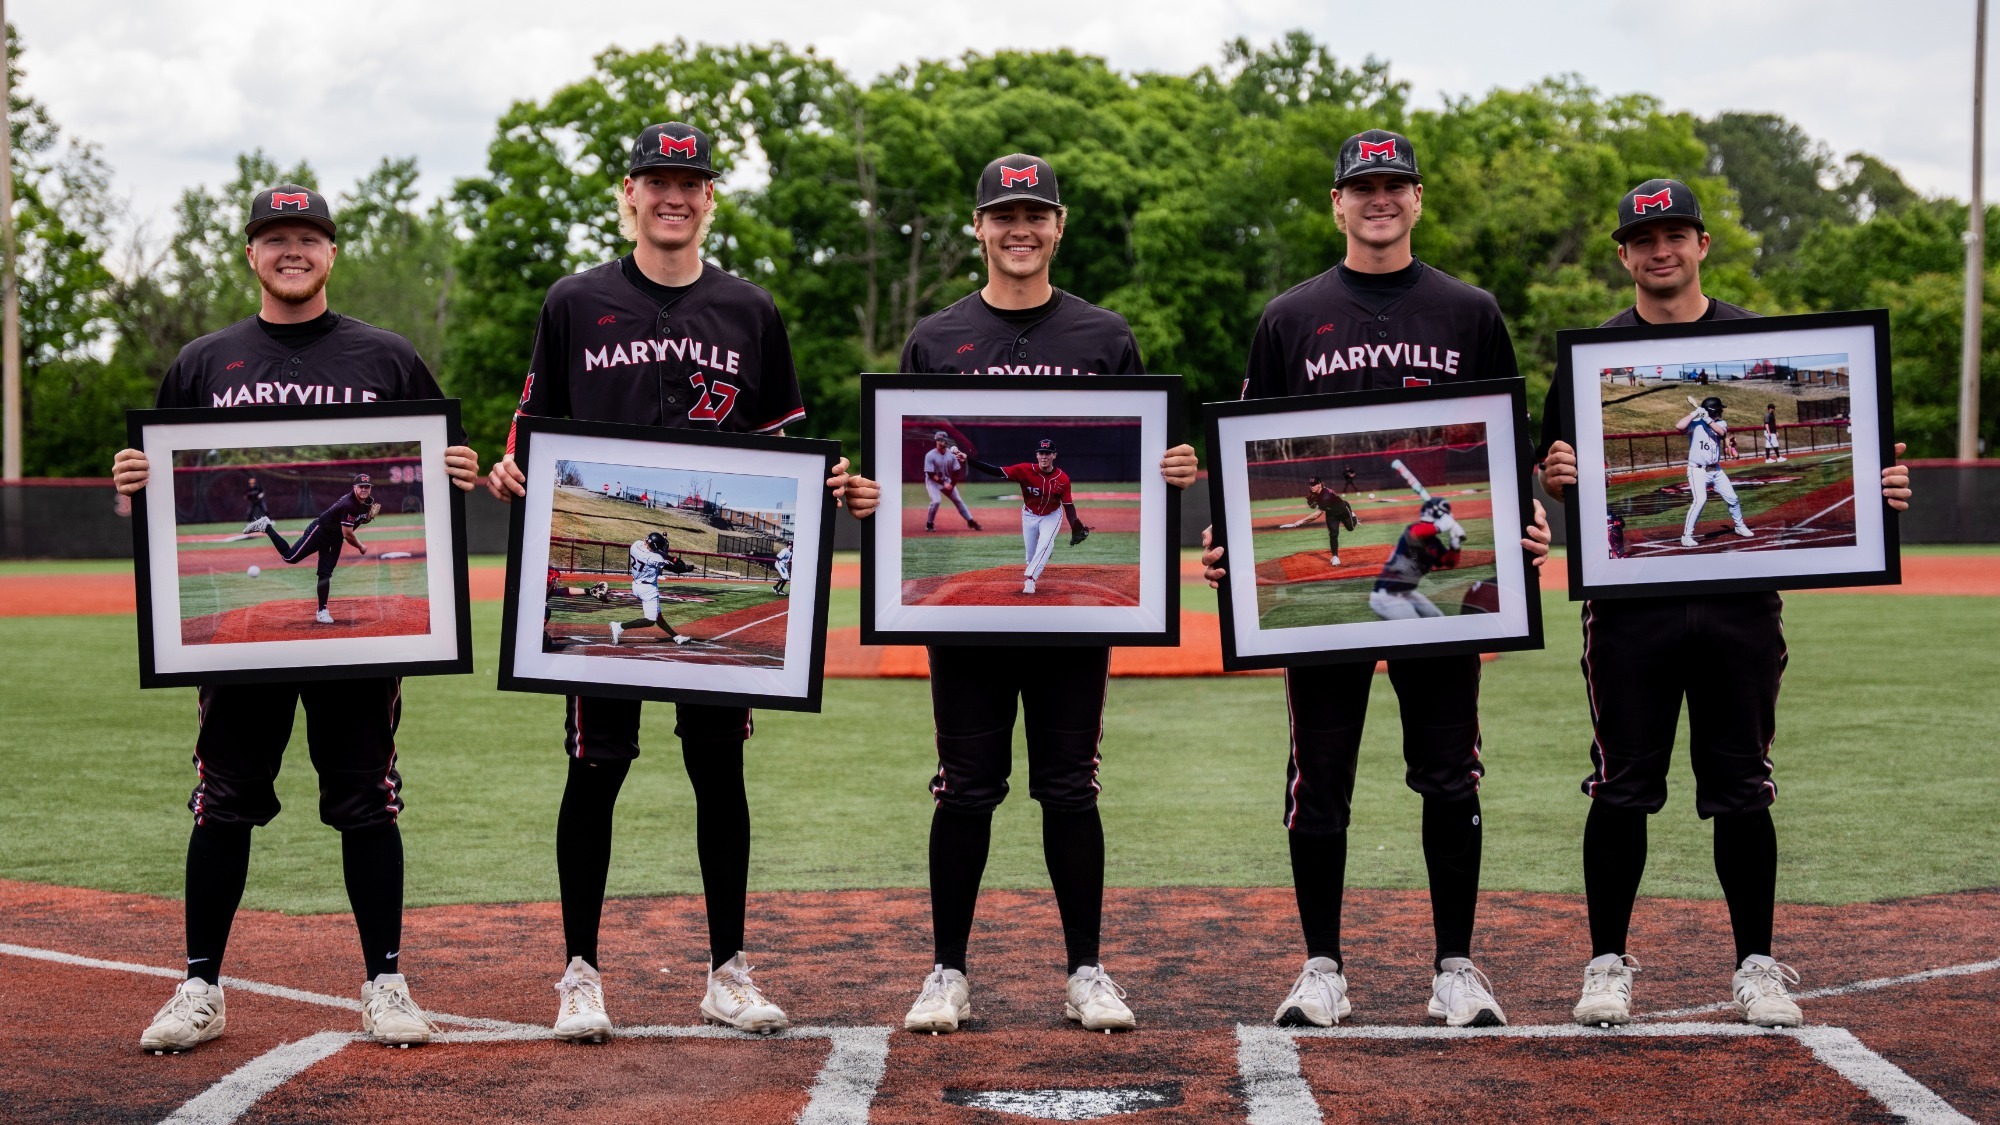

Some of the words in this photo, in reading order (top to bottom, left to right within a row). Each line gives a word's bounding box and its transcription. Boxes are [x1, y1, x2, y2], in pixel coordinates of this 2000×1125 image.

[659, 133, 697, 159] M
[1359, 138, 1397, 162] M
[1001, 164, 1039, 188] M
[270, 192, 309, 210] M
[1633, 187, 1673, 214] M
[585, 337, 740, 375] MARYVILLE
[1305, 342, 1461, 381] MARYVILLE
[688, 371, 740, 426] 27
[1699, 440, 1710, 451] 16
[1027, 486, 1040, 496] 15
[630, 554, 646, 572] 27
